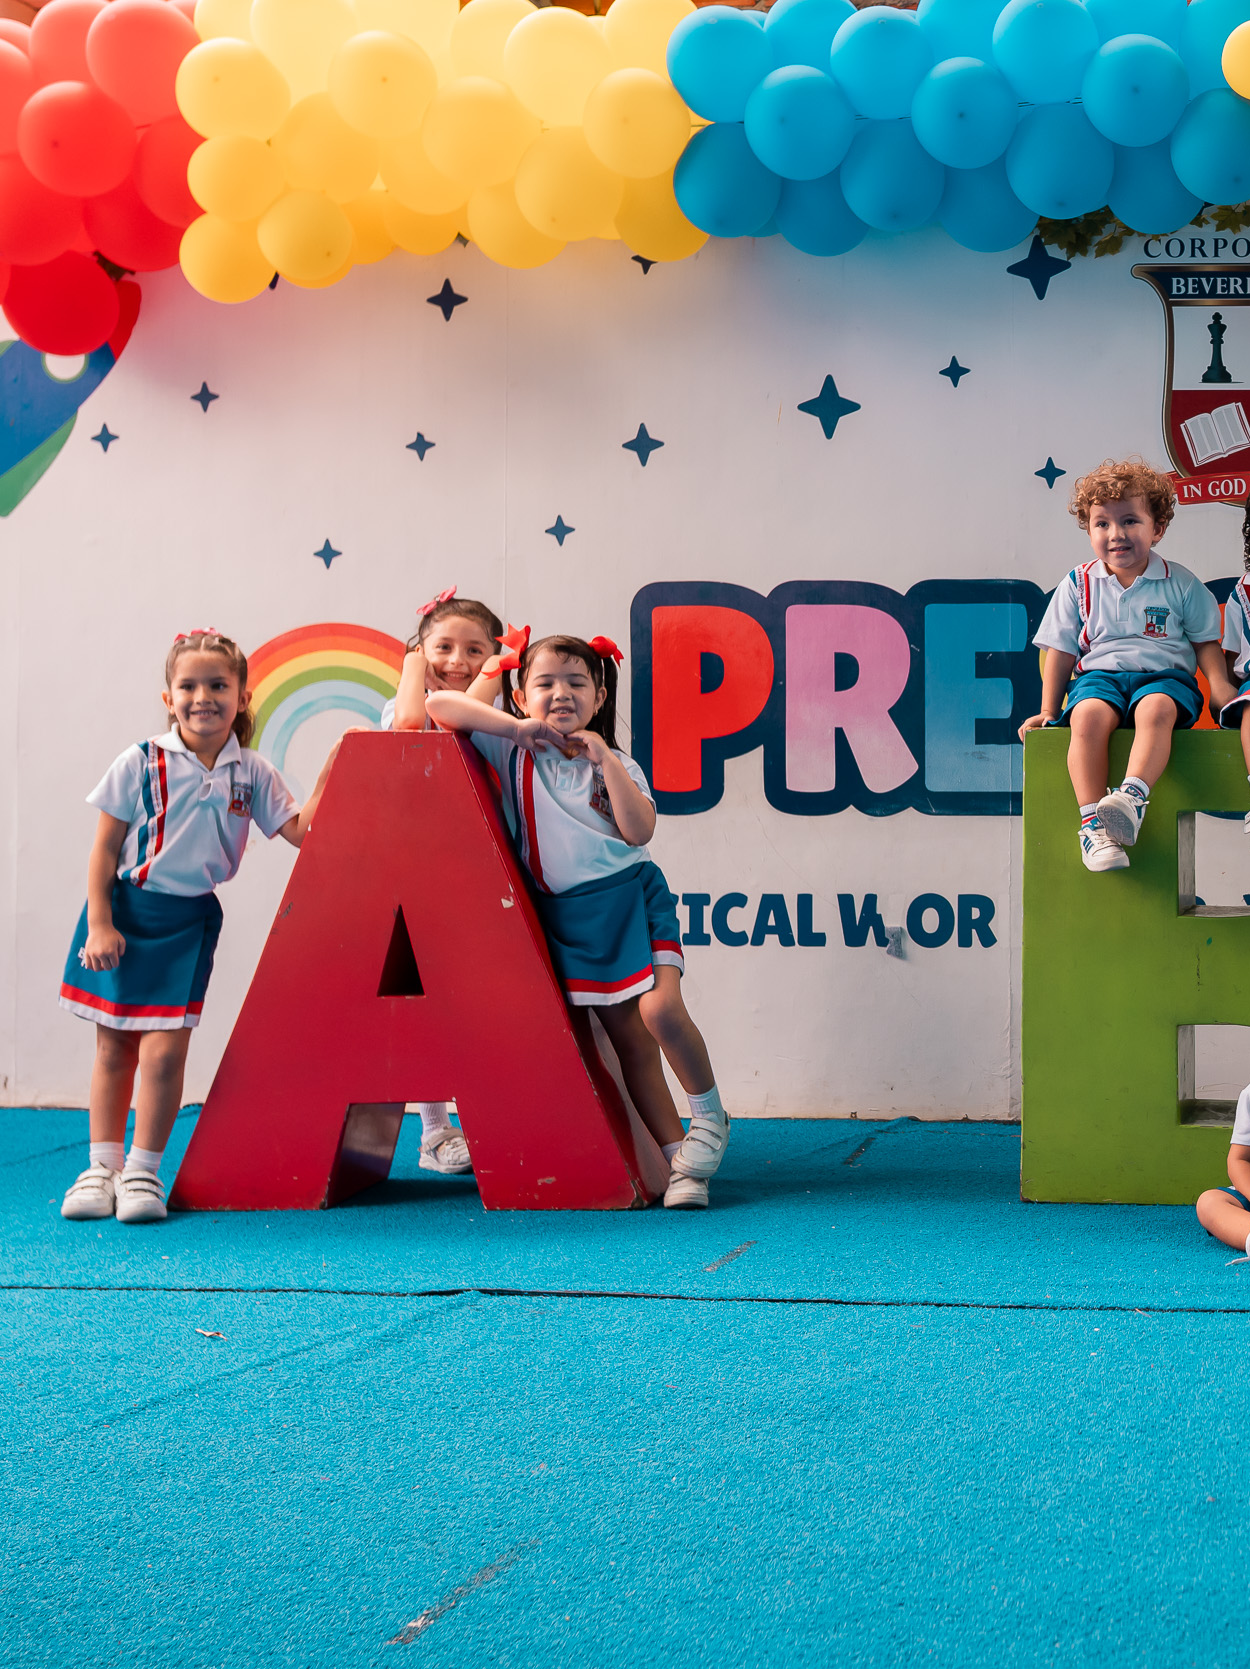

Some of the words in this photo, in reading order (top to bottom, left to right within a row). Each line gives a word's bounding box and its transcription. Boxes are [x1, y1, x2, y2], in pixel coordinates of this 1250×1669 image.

[1183, 483, 1202, 498] IN
[1208, 478, 1247, 496] GOD
[670, 892, 826, 947] ICAL
